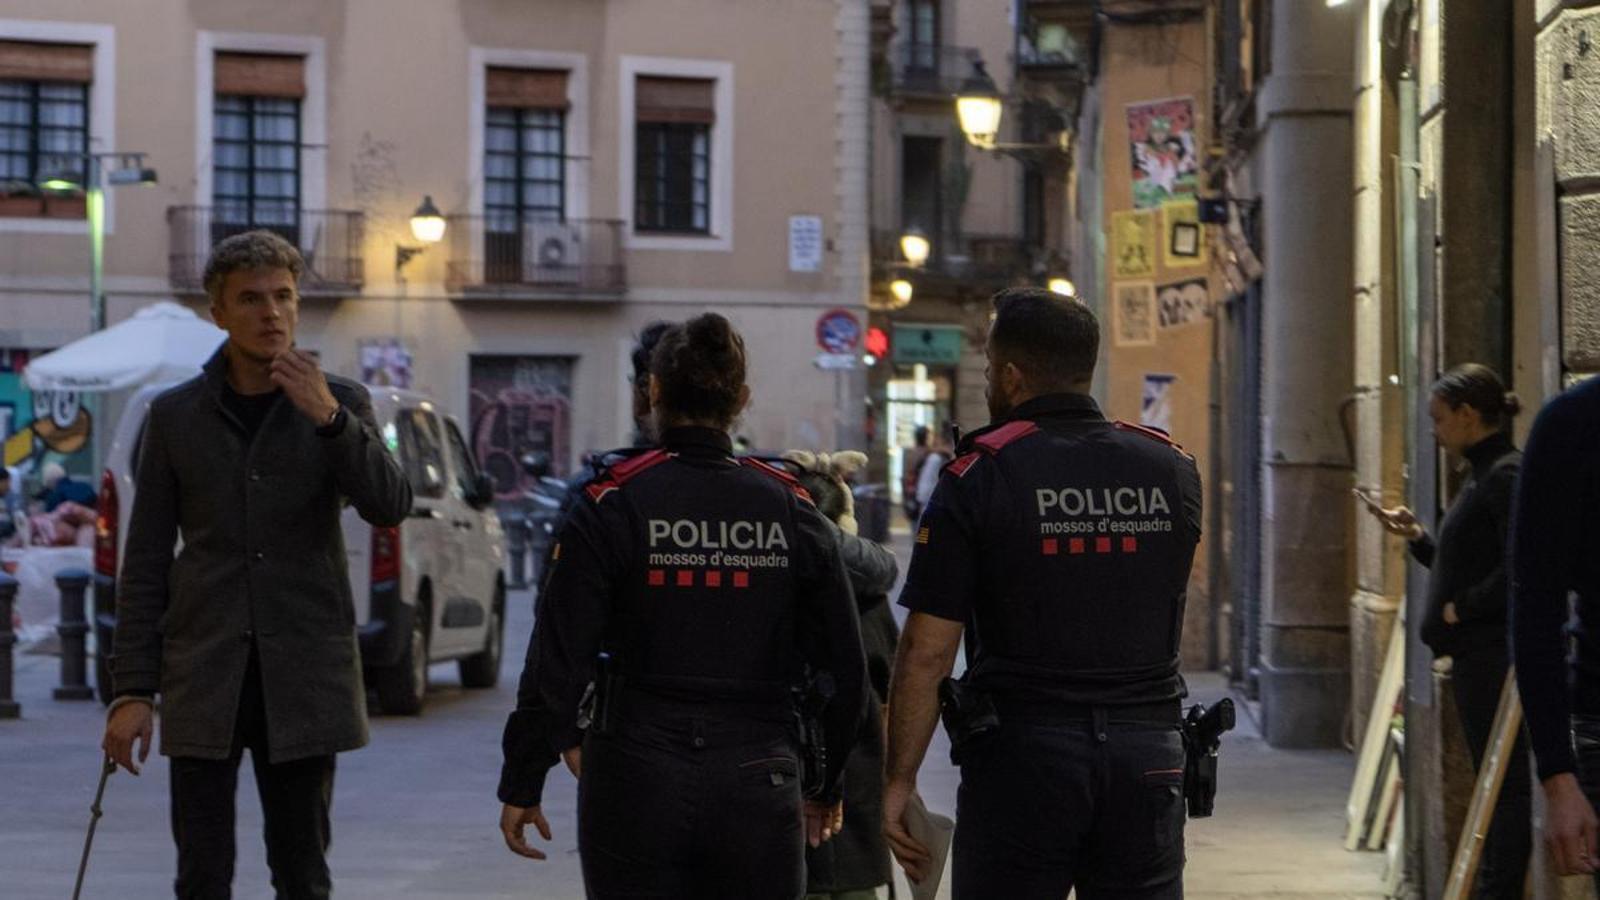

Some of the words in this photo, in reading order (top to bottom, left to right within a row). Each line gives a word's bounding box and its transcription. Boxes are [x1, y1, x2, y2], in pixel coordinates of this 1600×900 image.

[1036, 487, 1170, 516] POLICIA
[648, 519, 789, 549] POLICIA
[1041, 520, 1095, 534] mossos
[1098, 517, 1172, 534] d'esquadra
[649, 552, 706, 565] mossos
[710, 551, 789, 568] d'esquadra
